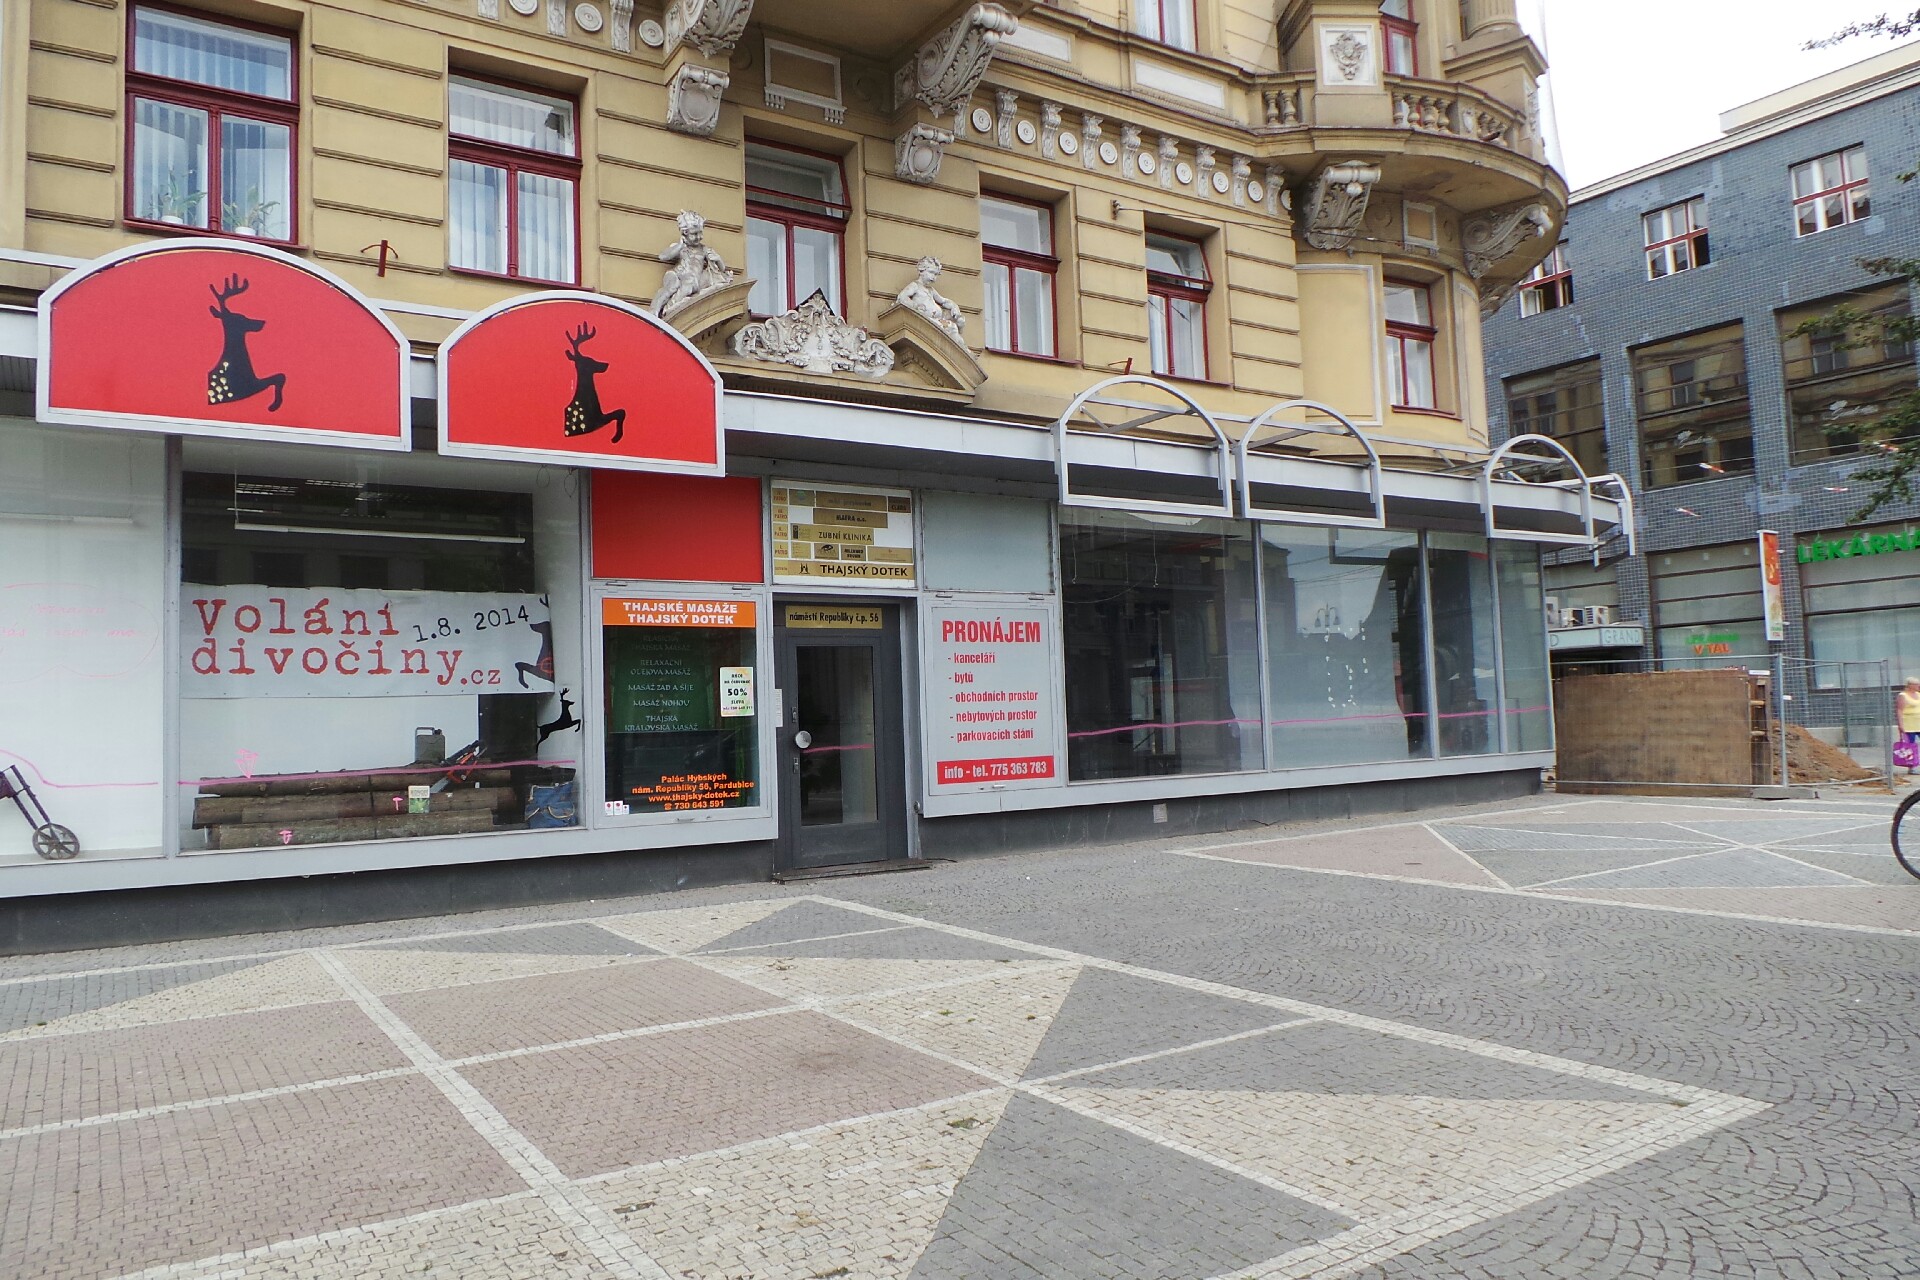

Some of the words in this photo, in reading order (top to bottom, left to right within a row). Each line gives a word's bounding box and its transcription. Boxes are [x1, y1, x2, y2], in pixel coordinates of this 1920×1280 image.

[818, 530, 841, 540] ZUBNÍ
[843, 533, 872, 541] KLINIKA
[820, 564, 867, 577] THAJSKÝ
[871, 567, 908, 577] DOTEK
[623, 601, 684, 613] THAJSKÉ
[687, 602, 738, 614] MASÁŽE
[192, 597, 400, 636] Volání
[628, 613, 688, 624] THAJSKÝ
[692, 615, 734, 625] DOTEK
[789, 612, 817, 621] náměstí
[819, 612, 853, 624] Republiky
[855, 613, 868, 624] č.p.
[869, 613, 879, 622] 56
[413, 617, 461, 642] 1.8.
[474, 605, 530, 631] 2014
[942, 617, 1041, 643] PRONÁJEM
[1603, 630, 1640, 644] GRAND
[191, 638, 501, 686] divočiny.cz
[954, 652, 995, 664] kanceláří
[954, 671, 974, 684] bytů
[728, 687, 748, 697] 50%
[955, 690, 1006, 703] obchodních
[1008, 690, 1038, 703] prostor
[956, 709, 1005, 723] nebytových
[1007, 709, 1037, 723] prostor
[957, 729, 1011, 743] parkovacích
[1013, 728, 1034, 740] stání
[944, 766, 963, 779] info
[973, 764, 988, 777] tel.
[990, 764, 1008, 776] 775
[1010, 763, 1028, 775] 363
[1030, 762, 1047, 774] 783
[661, 775, 685, 784] Palác
[687, 773, 727, 783] Hybských
[632, 786, 653, 794] nám.
[655, 784, 697, 794] Republiky
[699, 783, 712, 792] 56,
[714, 781, 755, 790] Pardubice
[648, 791, 740, 803] www.thajsky-dotek.cz
[675, 802, 690, 810] 730
[692, 801, 707, 809] 643
[709, 800, 724, 808] 591
